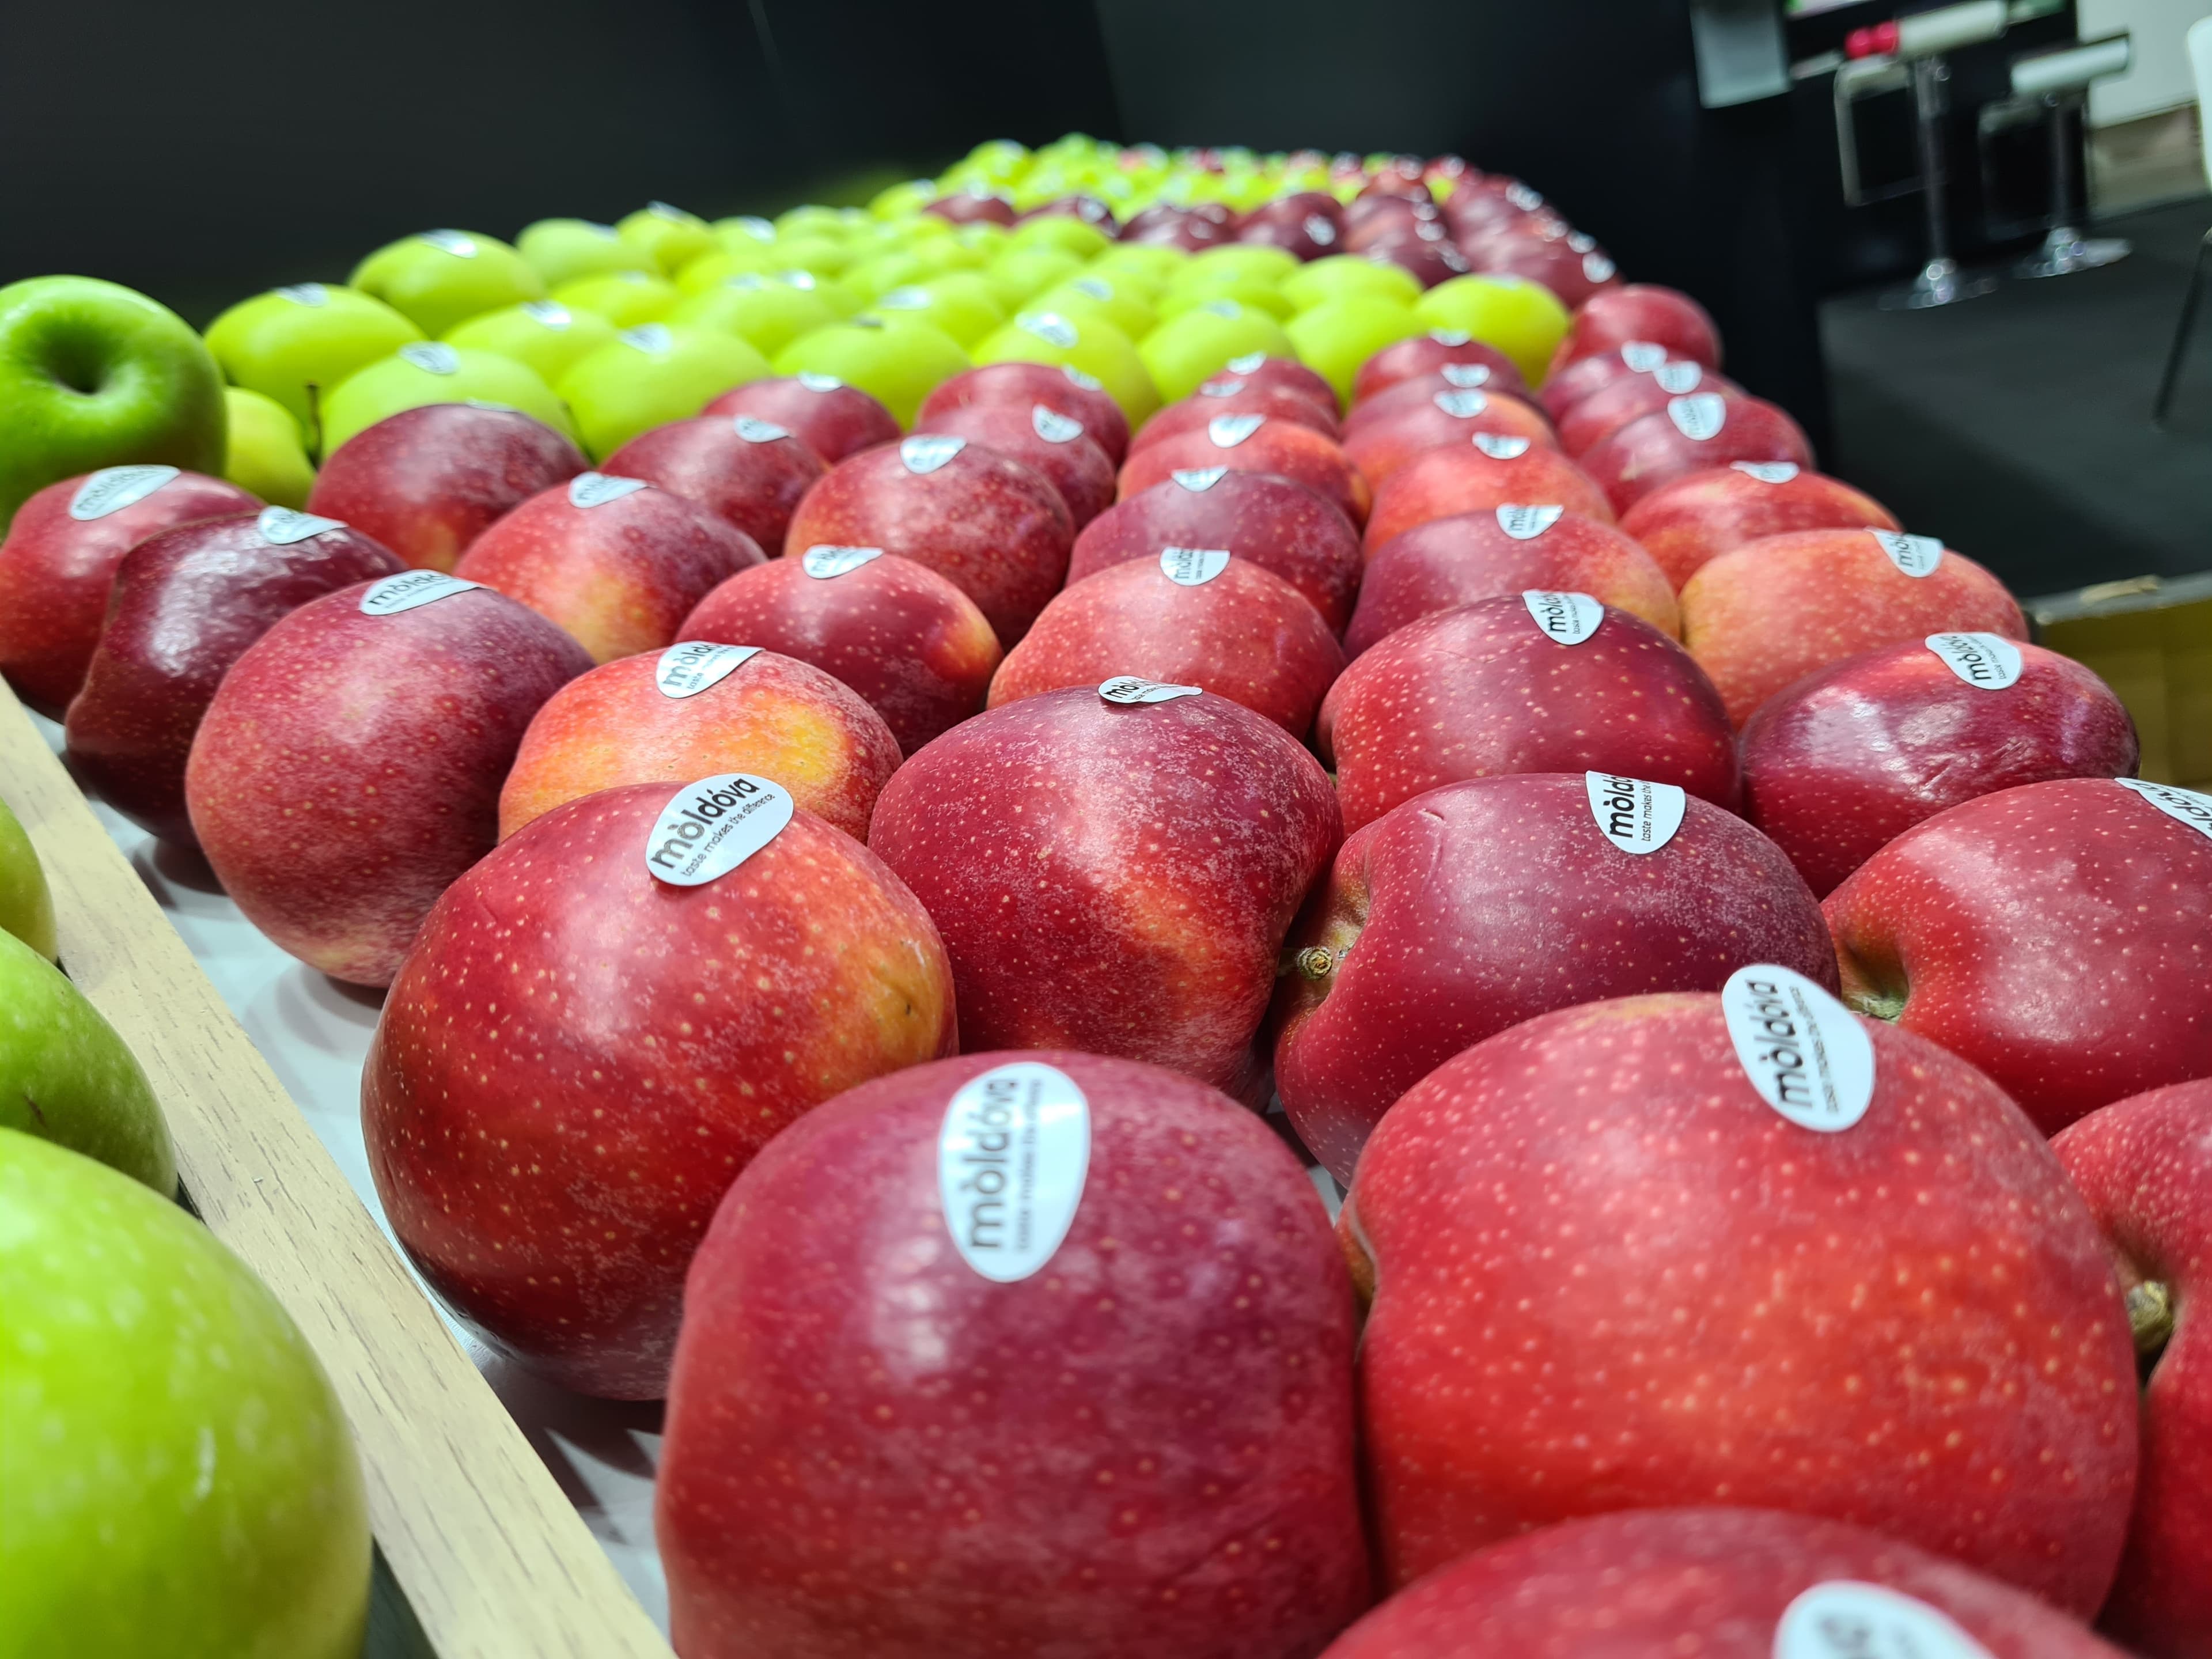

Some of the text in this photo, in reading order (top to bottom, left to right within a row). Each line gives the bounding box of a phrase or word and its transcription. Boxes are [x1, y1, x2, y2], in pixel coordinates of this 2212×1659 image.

[650, 778, 761, 870] mòldóva
[680, 793, 776, 877] taste makes the difference
[1641, 794, 1653, 820] makes
[1641, 821, 1652, 842] taste
[1743, 979, 1813, 1109] mòldóva
